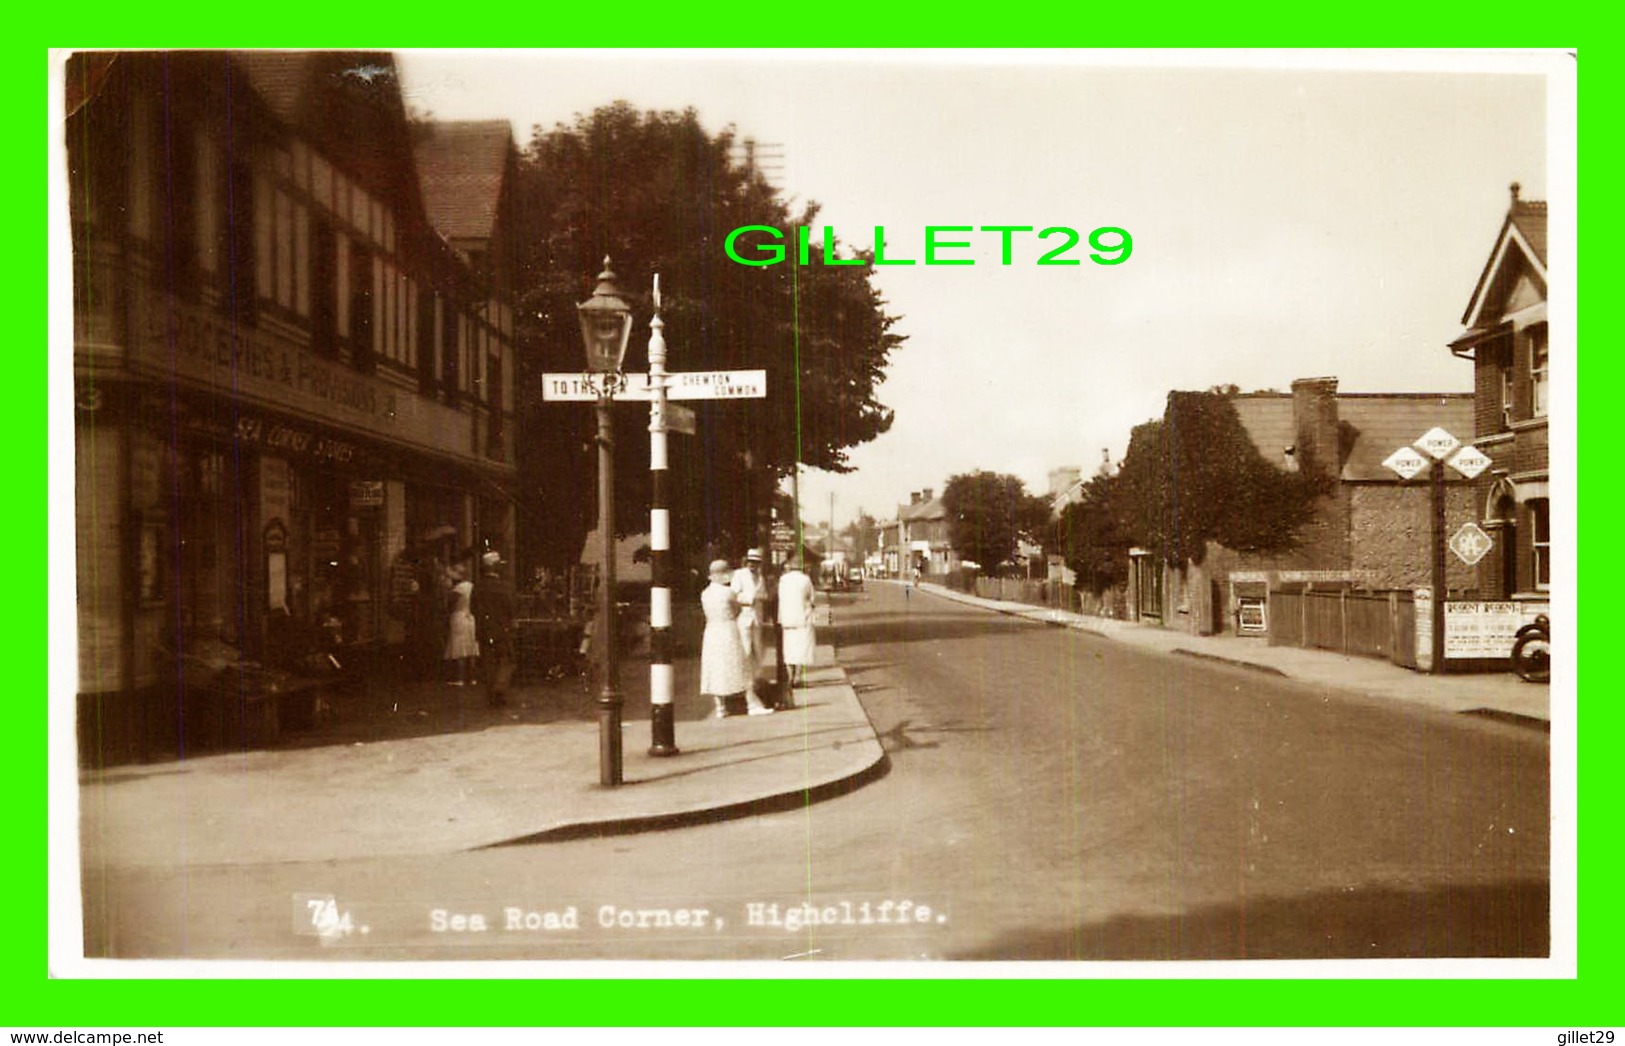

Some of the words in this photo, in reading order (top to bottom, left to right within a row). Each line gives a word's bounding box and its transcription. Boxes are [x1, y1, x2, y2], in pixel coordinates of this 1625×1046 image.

[683, 374, 730, 386] CHEWTON
[553, 380, 567, 394] TO
[715, 385, 757, 396] COMMON
[235, 416, 262, 441] SEA
[1396, 459, 1421, 467] POWER
[1459, 459, 1484, 467] POWER
[1448, 604, 1479, 613] REGENT
[1484, 604, 1515, 613] REGENT
